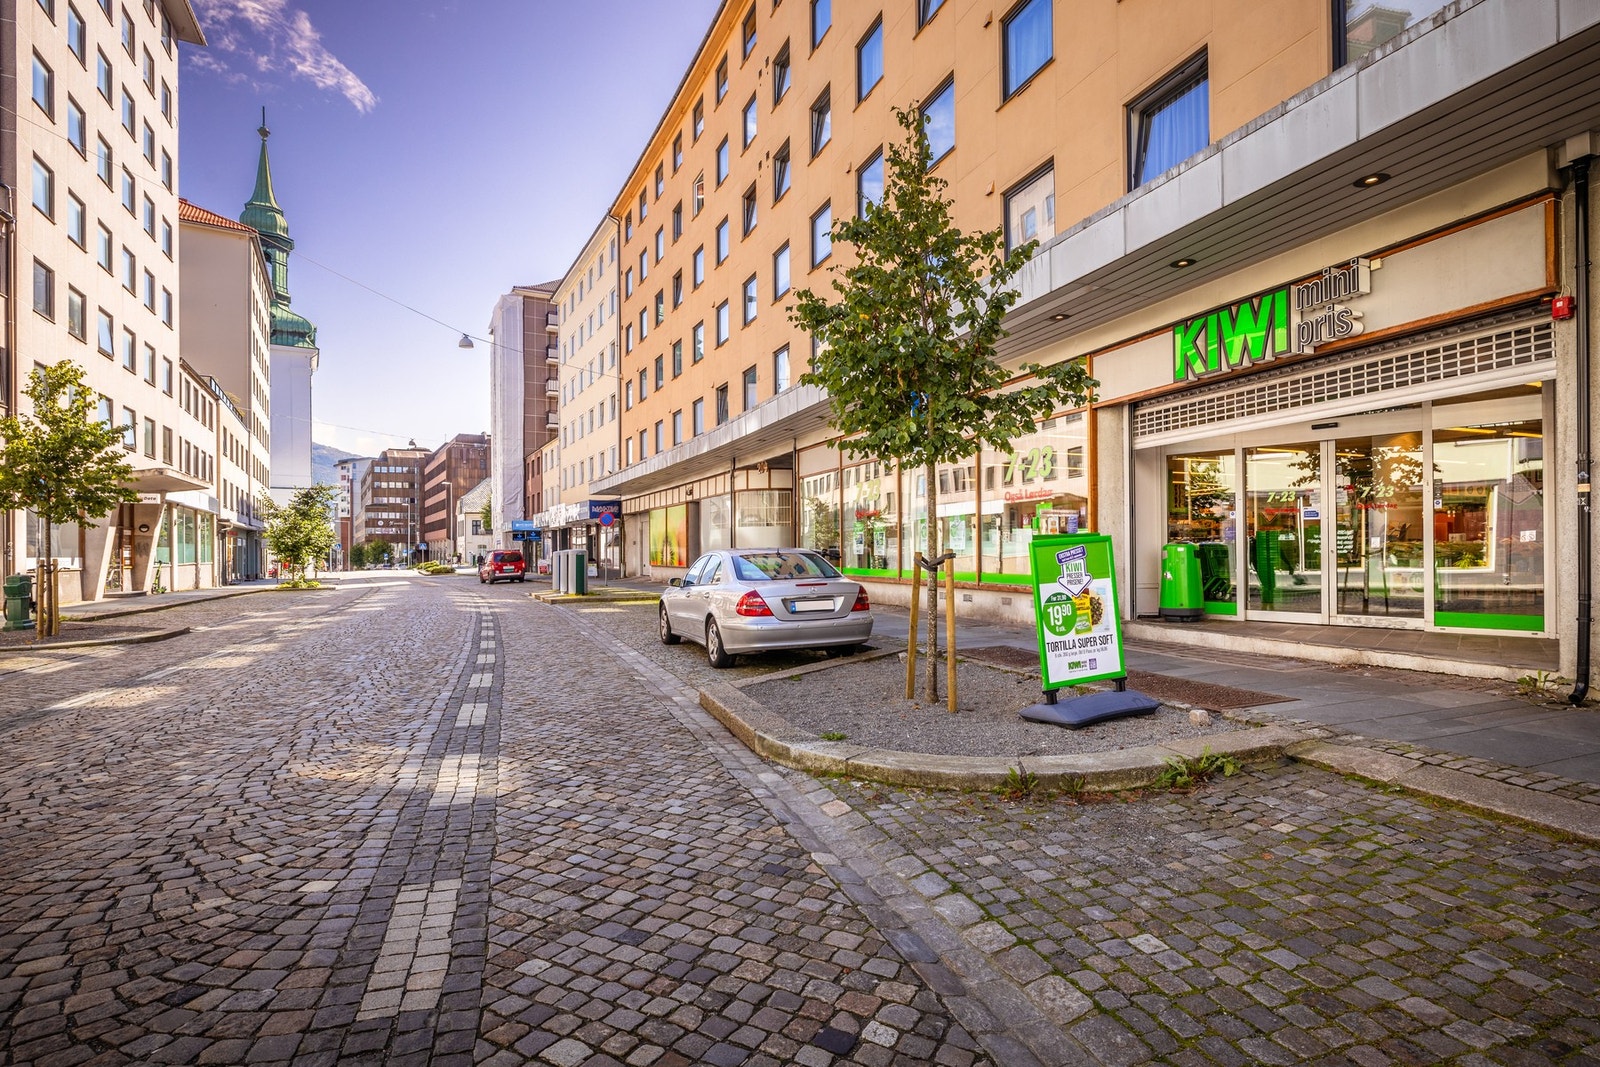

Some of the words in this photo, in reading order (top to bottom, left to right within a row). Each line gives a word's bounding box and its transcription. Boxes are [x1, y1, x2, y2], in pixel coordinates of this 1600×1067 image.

[1295, 257, 1360, 311] mini
[1173, 285, 1292, 383] KIWI
[1296, 304, 1353, 353] pris
[1005, 445, 1054, 482] 7-23
[1267, 491, 1296, 502] 7-23
[1361, 486, 1394, 498] 7-23
[1065, 562, 1083, 573] KIWI
[1046, 639, 1077, 653] TORTILLA
[1078, 636, 1098, 649] SUPER
[1098, 634, 1114, 646] SOFT
